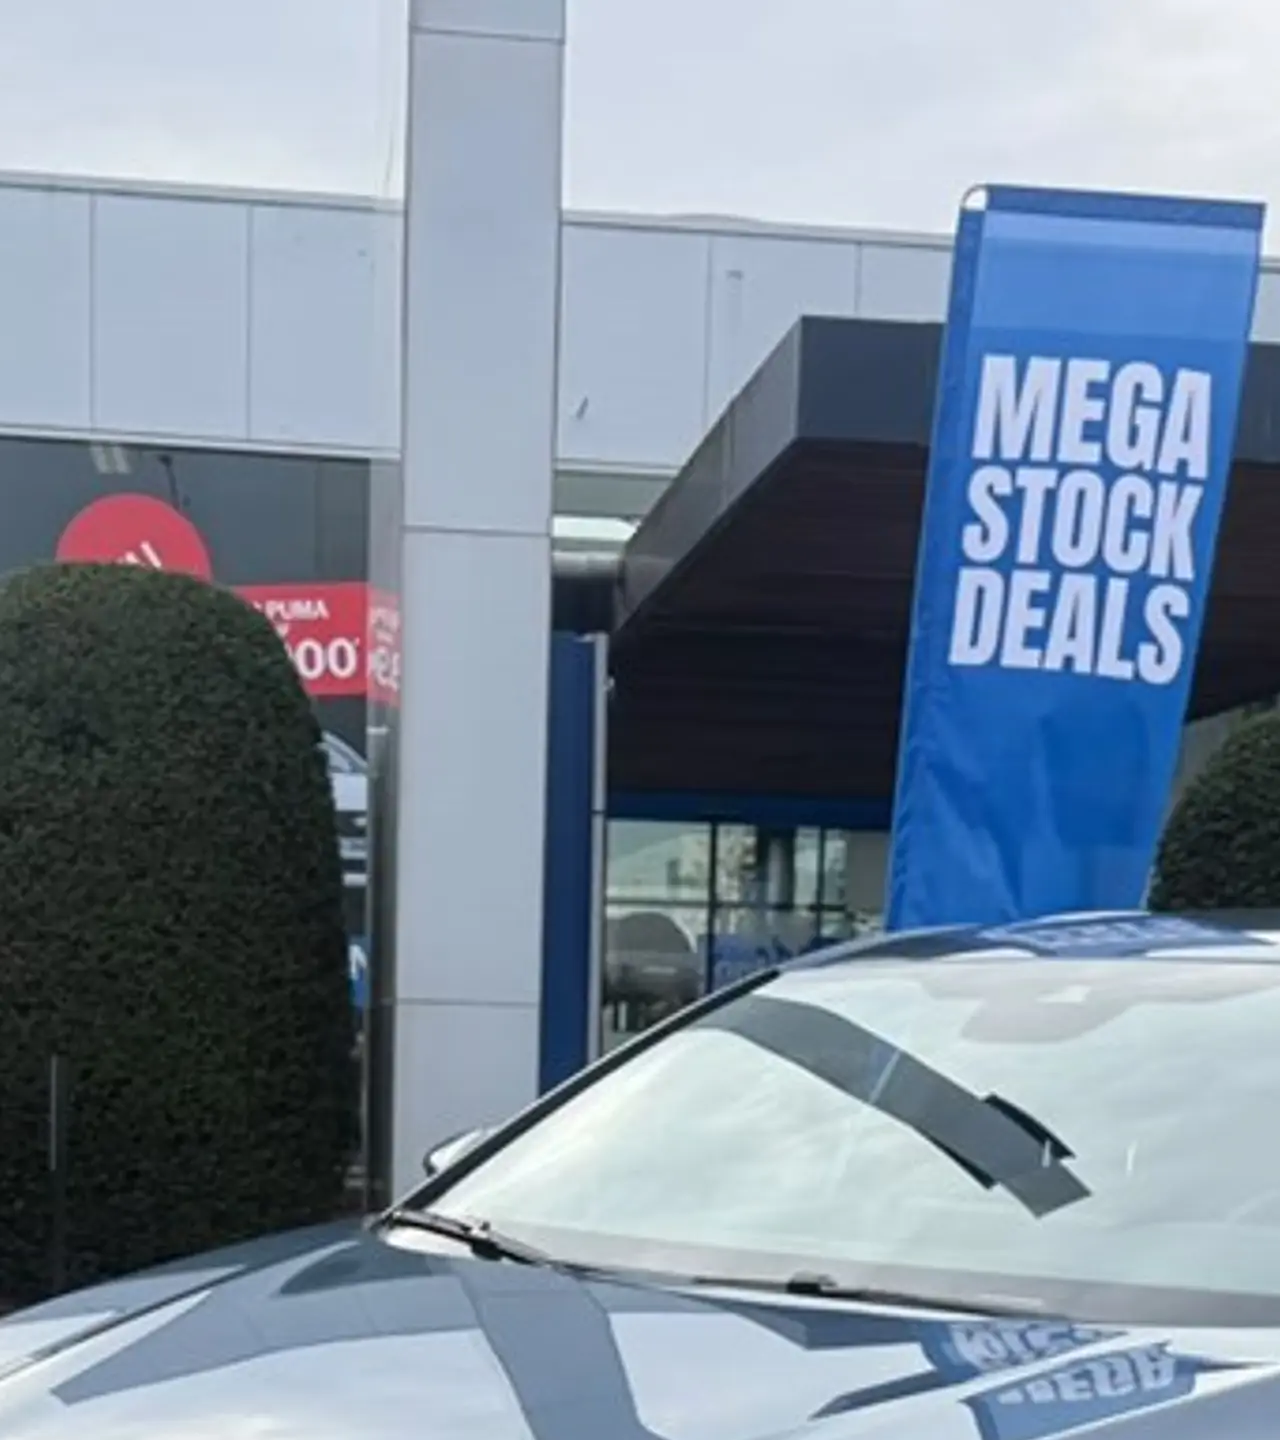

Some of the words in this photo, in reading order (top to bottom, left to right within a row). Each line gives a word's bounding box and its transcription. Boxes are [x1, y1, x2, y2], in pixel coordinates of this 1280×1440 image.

[971, 353, 1212, 479] MEGA
[961, 464, 1204, 582] STOCK
[948, 566, 1191, 686] DEALS
